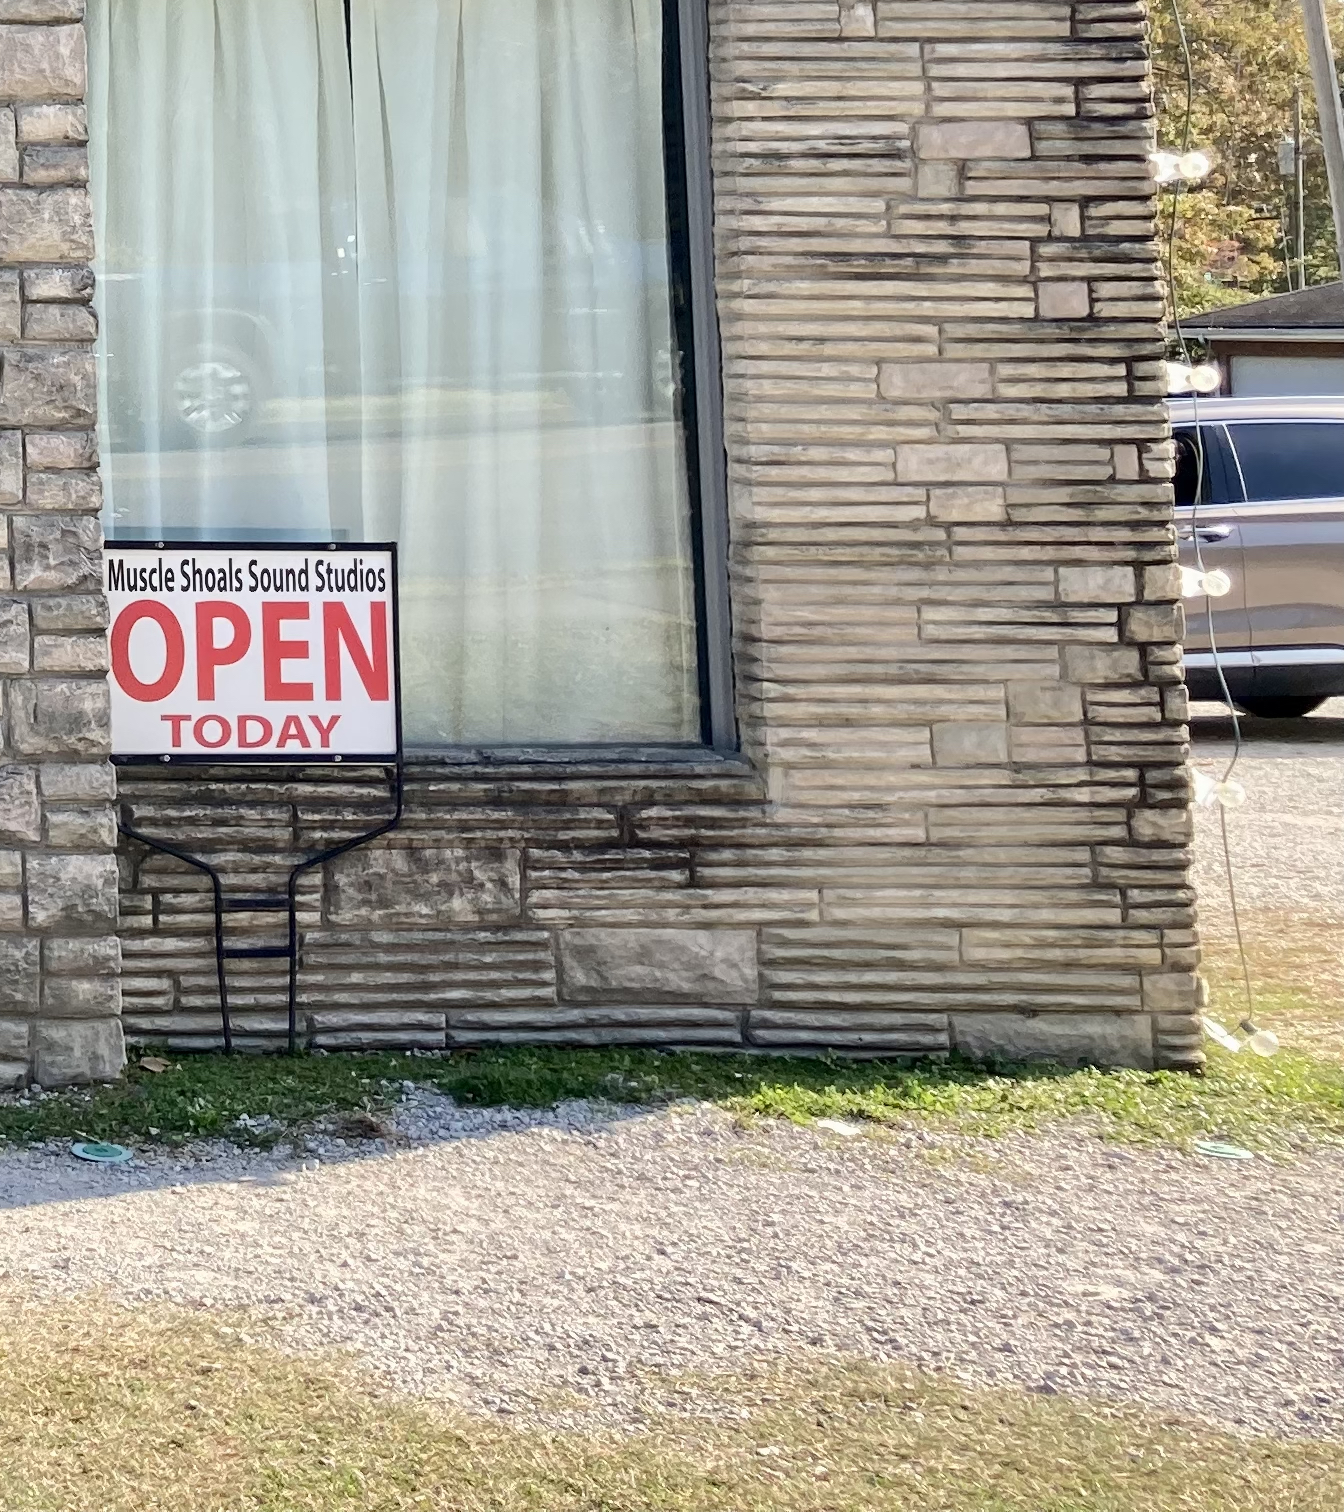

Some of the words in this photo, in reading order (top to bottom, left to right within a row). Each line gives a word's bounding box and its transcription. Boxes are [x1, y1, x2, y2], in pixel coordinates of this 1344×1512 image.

[108, 557, 175, 592] Muscle
[180, 557, 243, 593] Shoals
[248, 557, 310, 593] Sound
[315, 557, 386, 593] Studios
[110, 599, 390, 703] OPEN
[160, 714, 342, 749] TODAY
